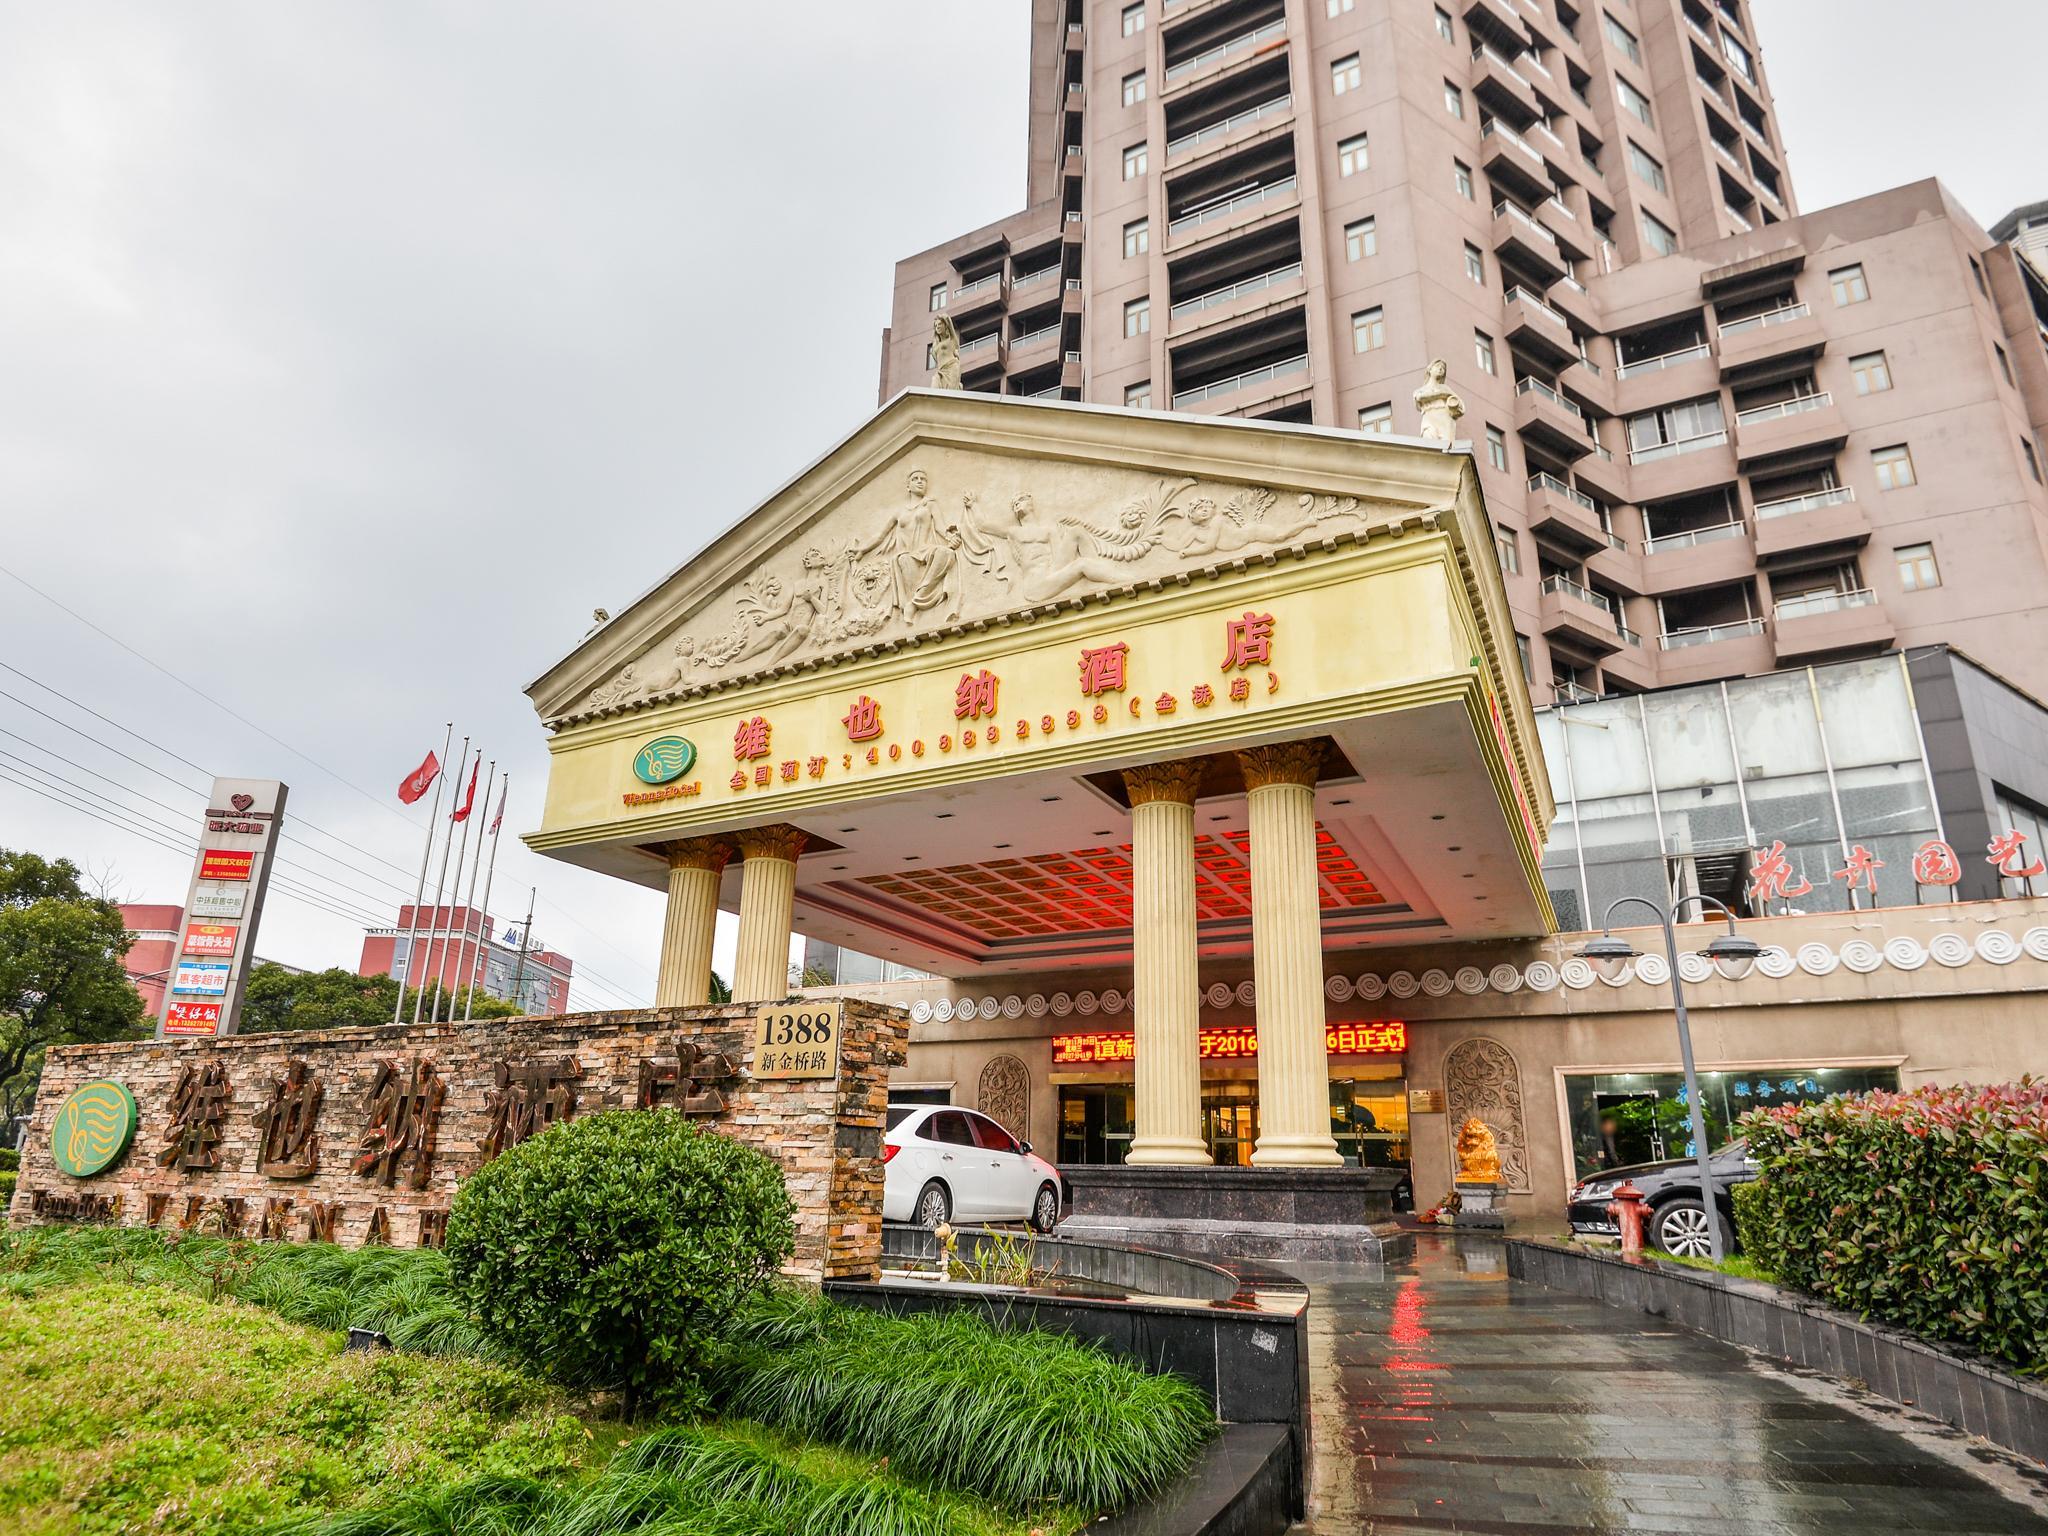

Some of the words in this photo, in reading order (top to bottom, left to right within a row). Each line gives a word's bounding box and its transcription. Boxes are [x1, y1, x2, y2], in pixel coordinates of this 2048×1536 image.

[732, 611, 1276, 762] 维也纳酒店
[1750, 829, 2047, 902] 花卉园艺
[178, 973, 224, 986] 惠客超市
[761, 1012, 831, 1046] 1388
[761, 1051, 827, 1071] 新金桥路
